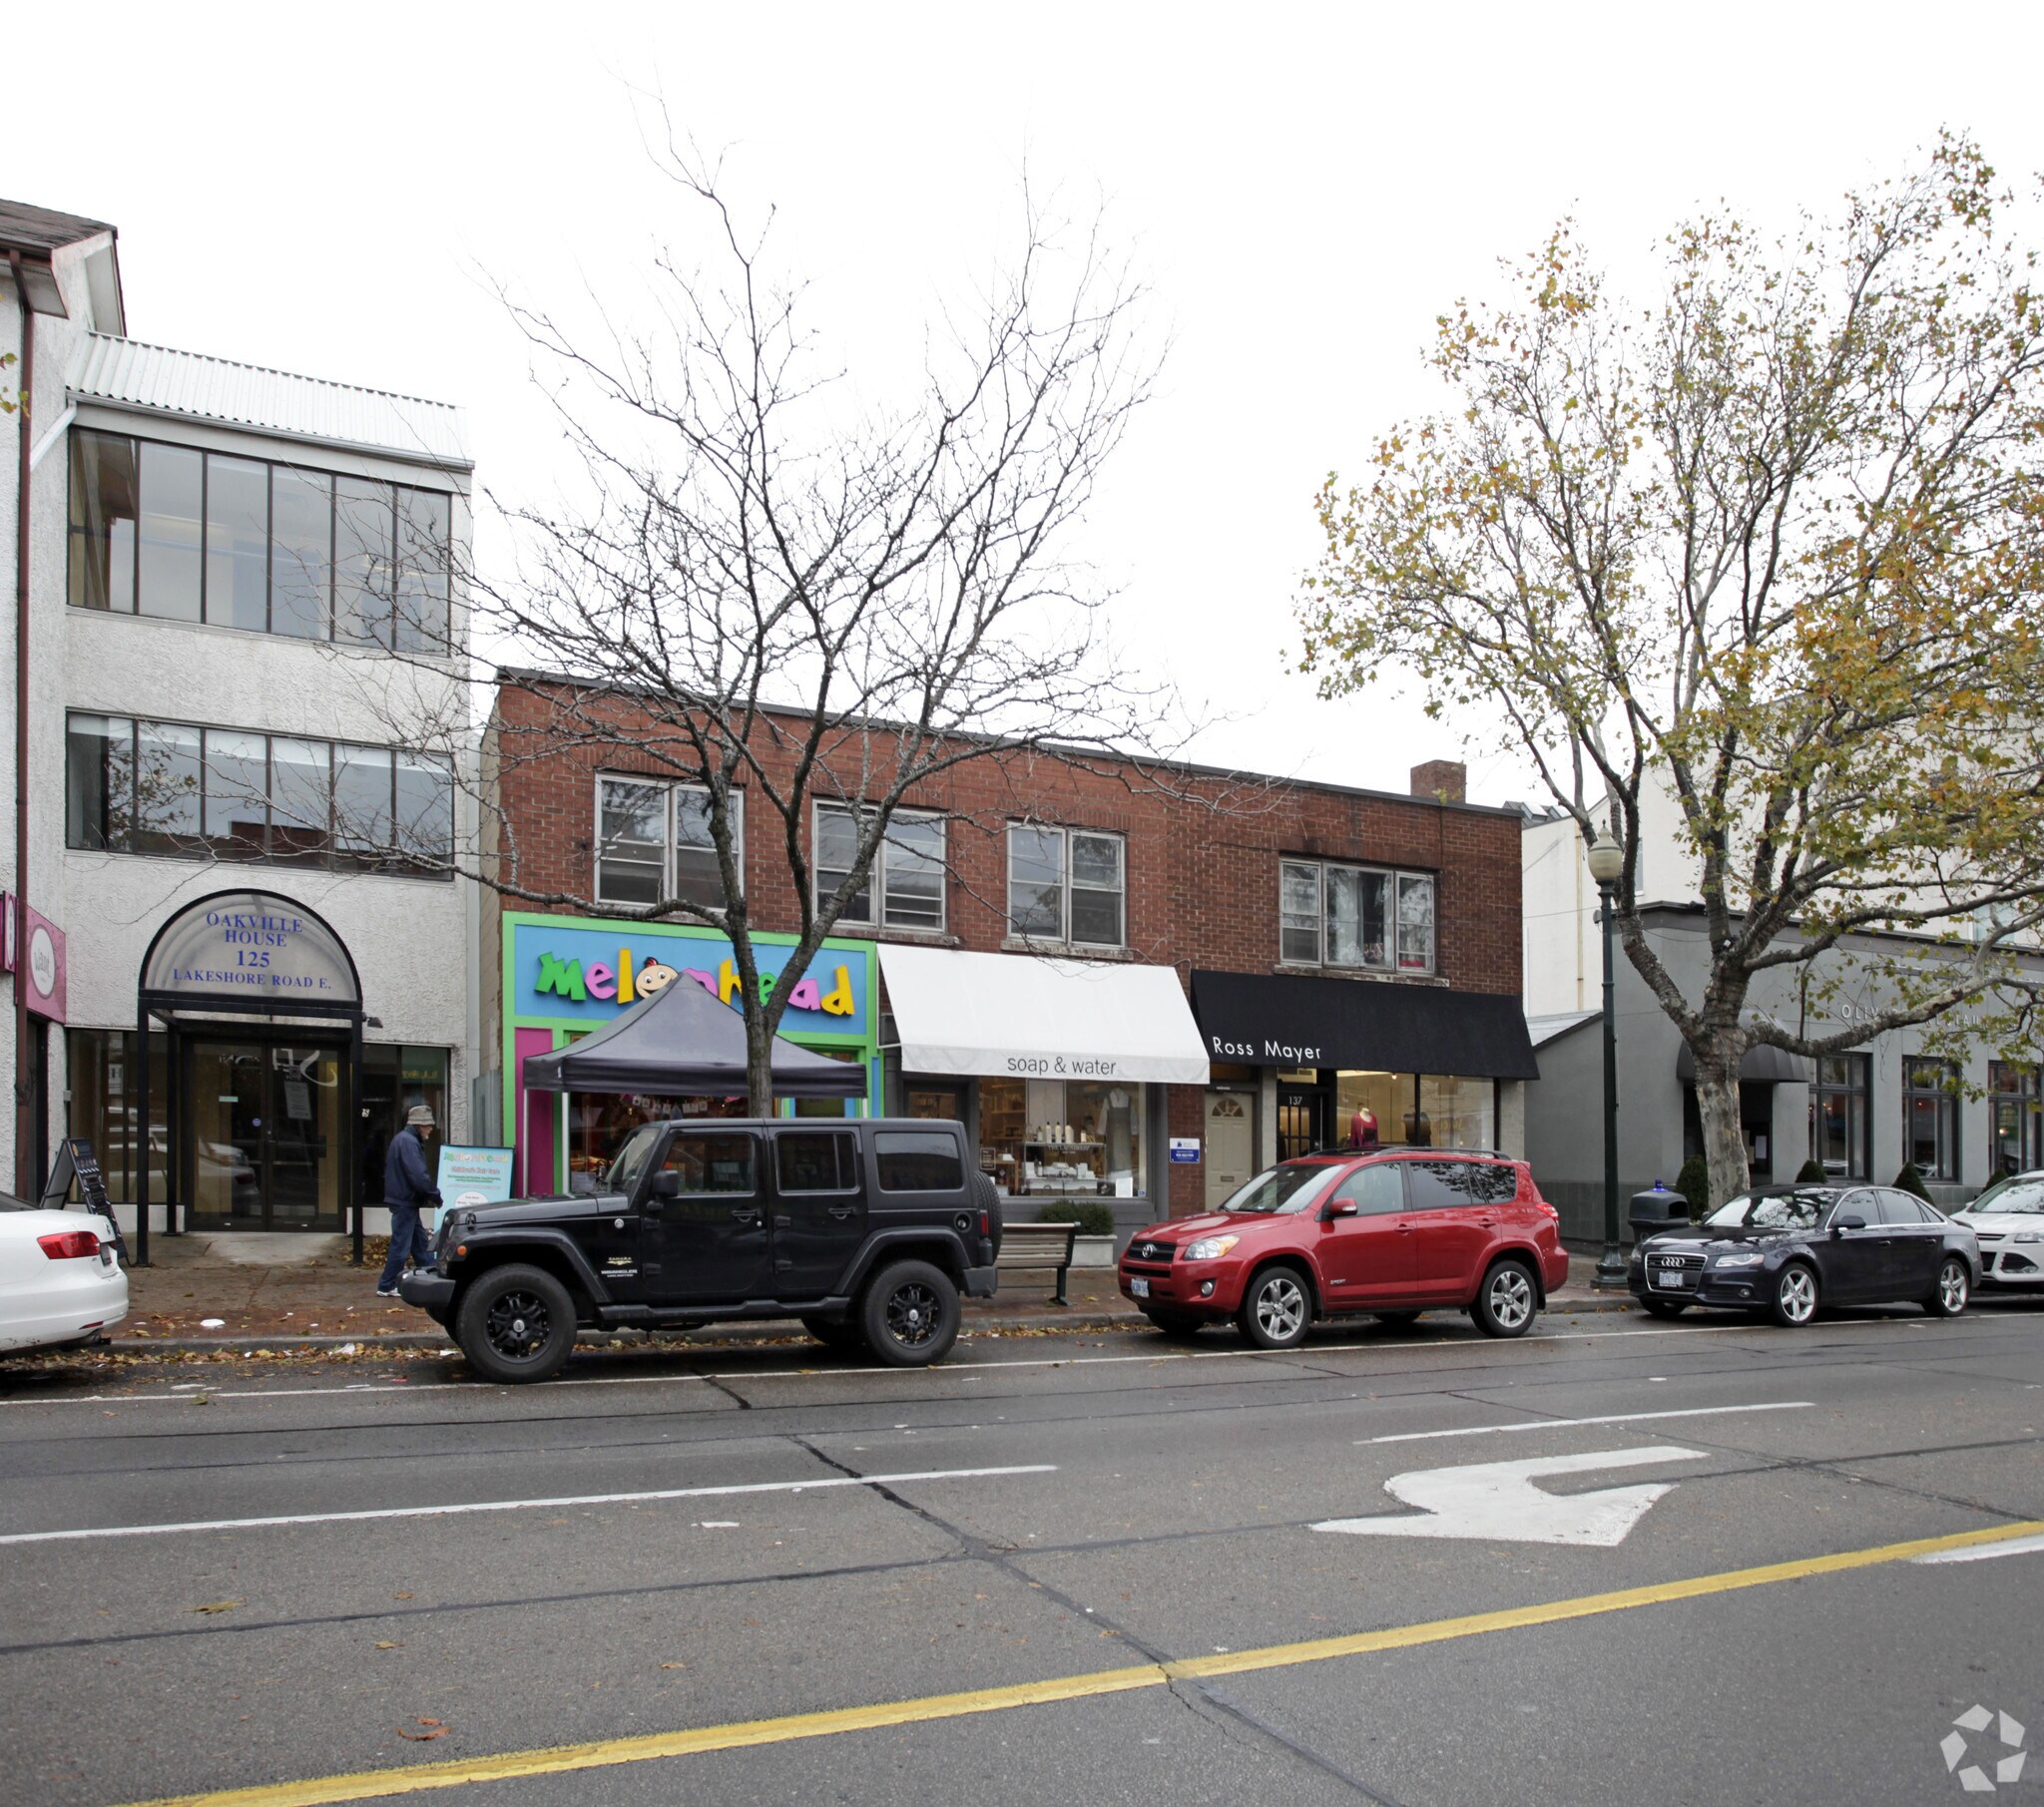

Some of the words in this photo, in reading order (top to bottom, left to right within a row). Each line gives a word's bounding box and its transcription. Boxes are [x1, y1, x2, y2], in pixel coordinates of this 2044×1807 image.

[206, 912, 303, 933] OAKVILLE
[224, 929, 287, 948] HOUSE
[236, 950, 270, 968] 125
[173, 968, 265, 986] LAKESHORE
[271, 974, 313, 989] ROAD
[318, 977, 331, 990] E.
[1212, 1036, 1255, 1057] Ross
[1265, 1040, 1321, 1064] Mayer
[1007, 1057, 1049, 1076] soap
[1054, 1056, 1066, 1074] &
[1072, 1060, 1117, 1075] water
[1288, 1096, 1303, 1106] 137
